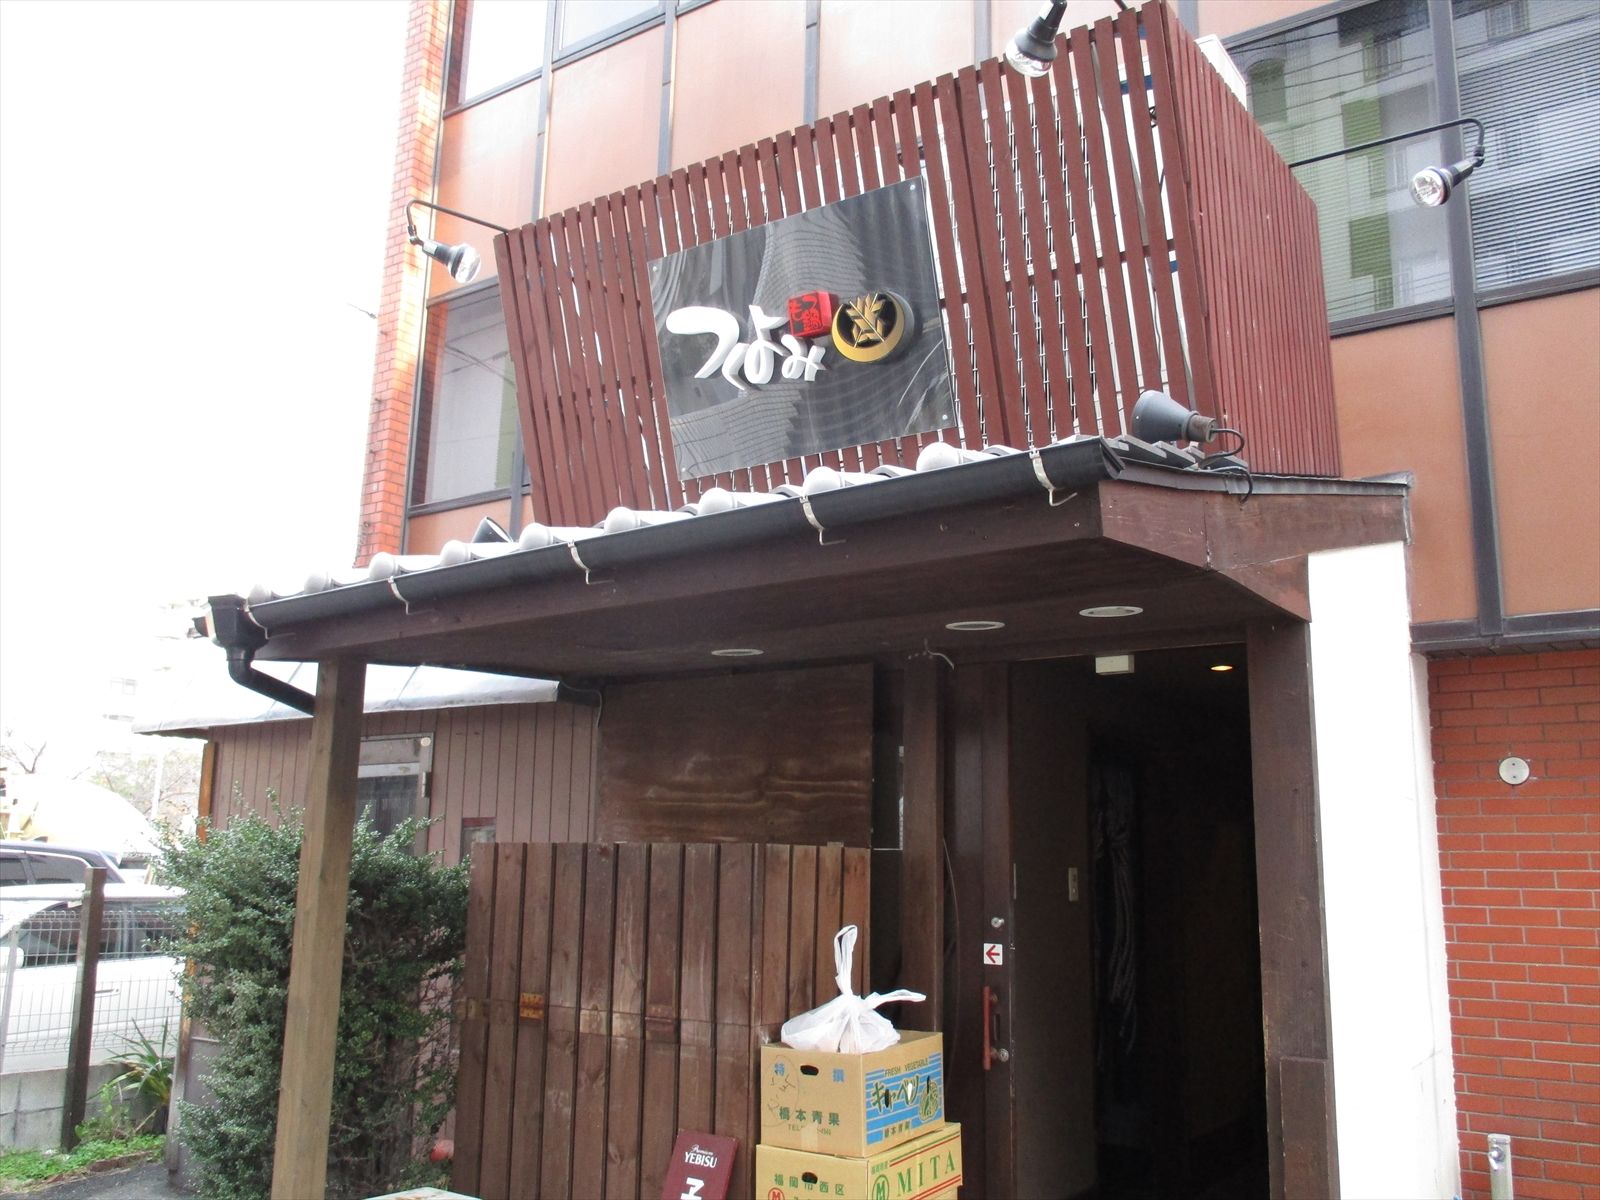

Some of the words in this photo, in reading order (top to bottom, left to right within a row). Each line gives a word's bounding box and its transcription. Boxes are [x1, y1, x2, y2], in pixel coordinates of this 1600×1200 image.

[665, 304, 827, 391] つくよみ
[684, 1152, 718, 1169] YEBISU
[897, 1150, 956, 1197] MITA
